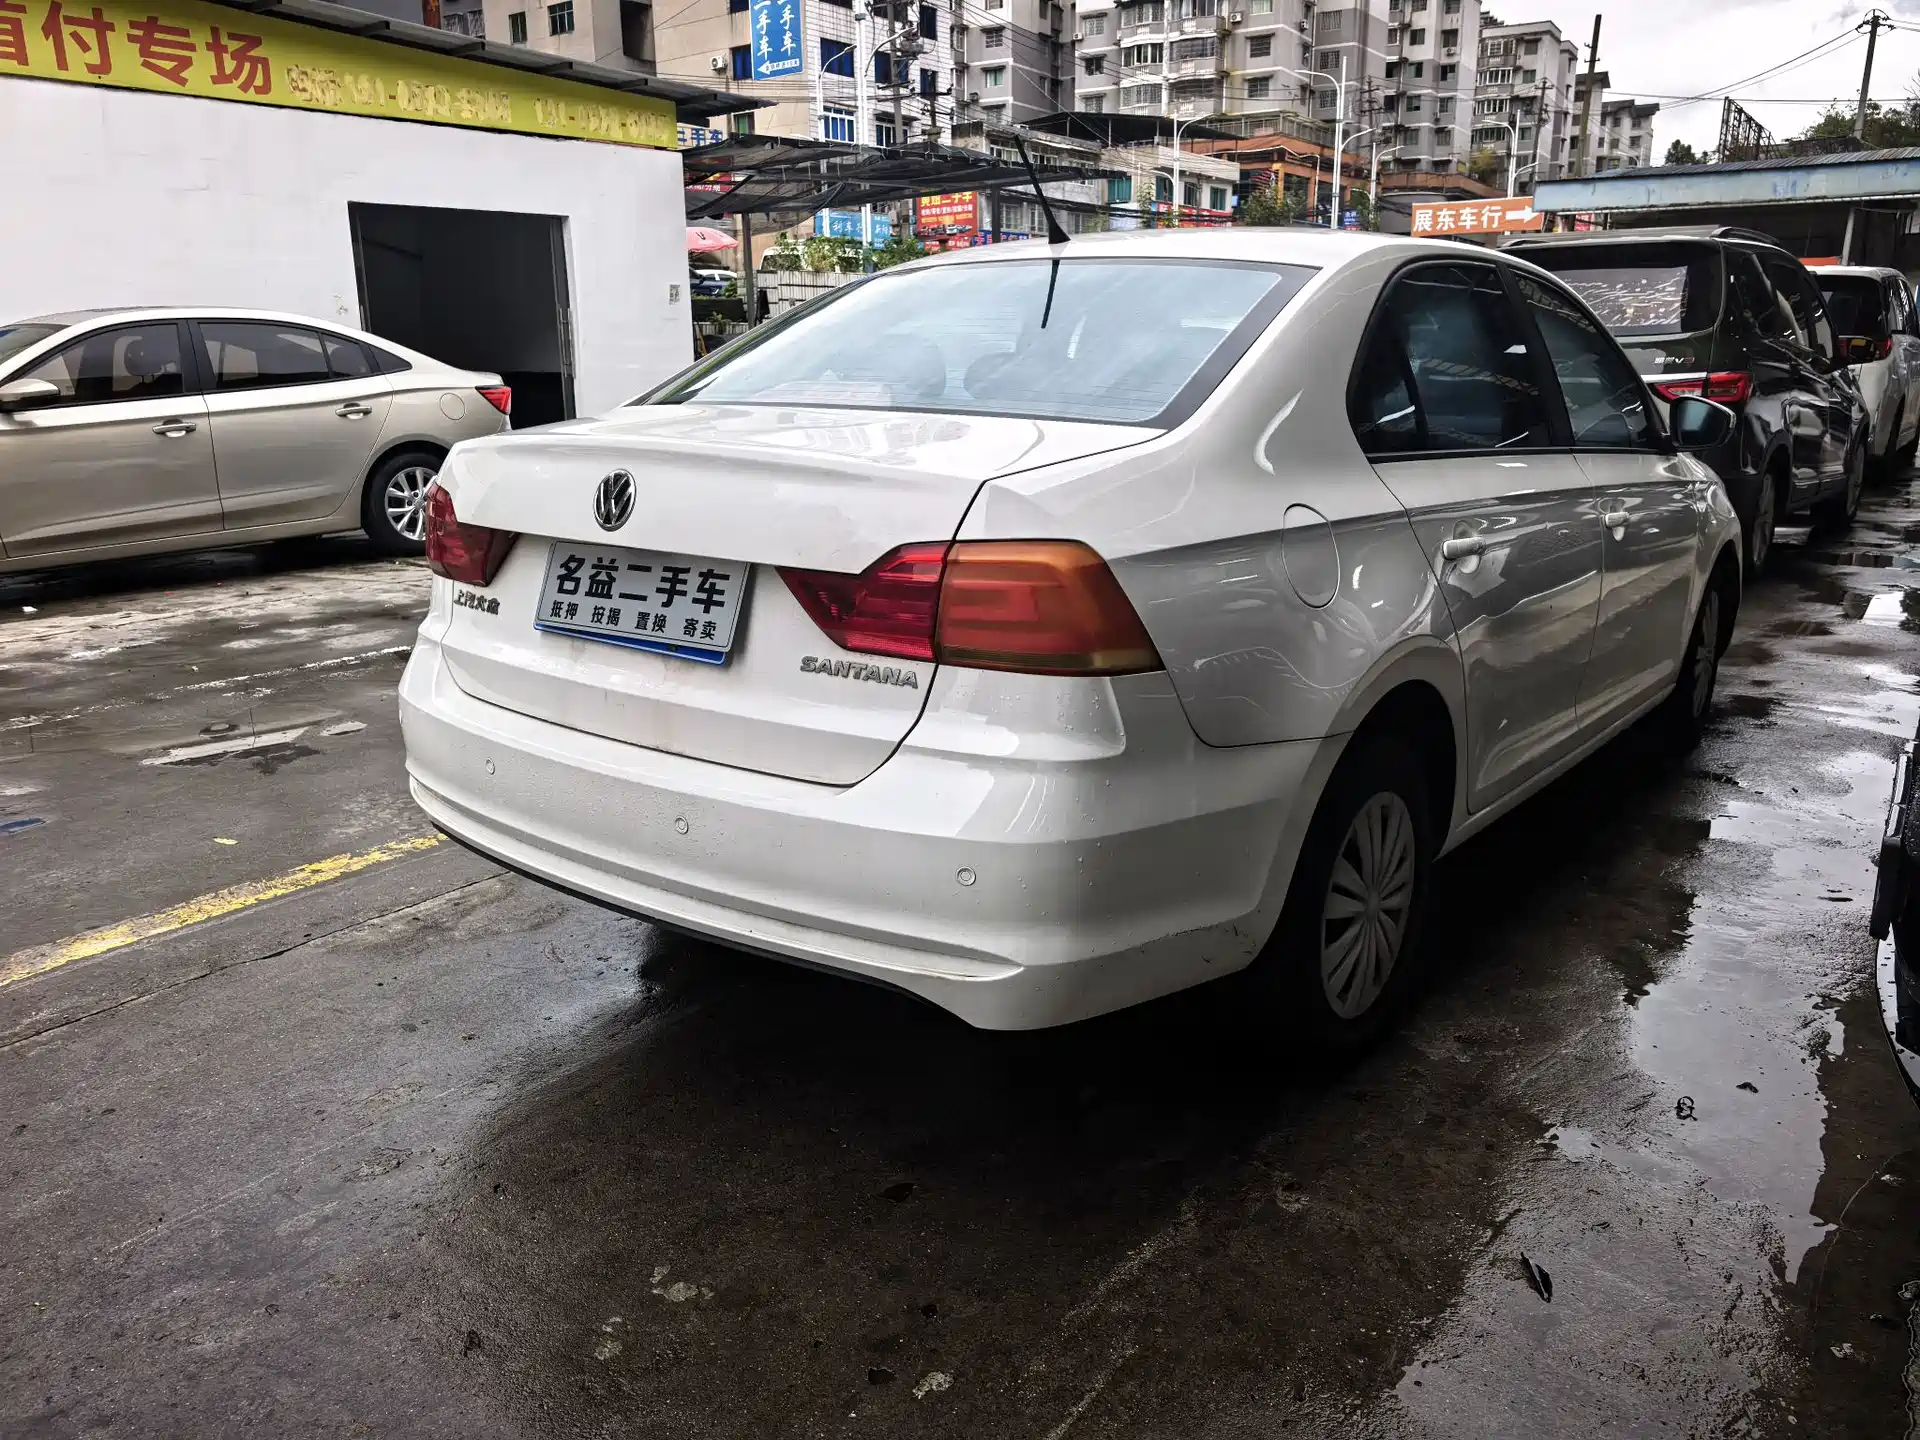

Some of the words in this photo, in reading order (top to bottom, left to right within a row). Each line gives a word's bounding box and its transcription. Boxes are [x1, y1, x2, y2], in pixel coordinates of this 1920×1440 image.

[1413, 205, 1500, 232] 展东车行
[556, 554, 731, 614] 名益二手车
[550, 600, 579, 621] 抵押
[590, 605, 622, 627] 按揭
[634, 611, 668, 634] 置换
[682, 617, 717, 641] 寄卖
[800, 655, 919, 689] SANTANA
